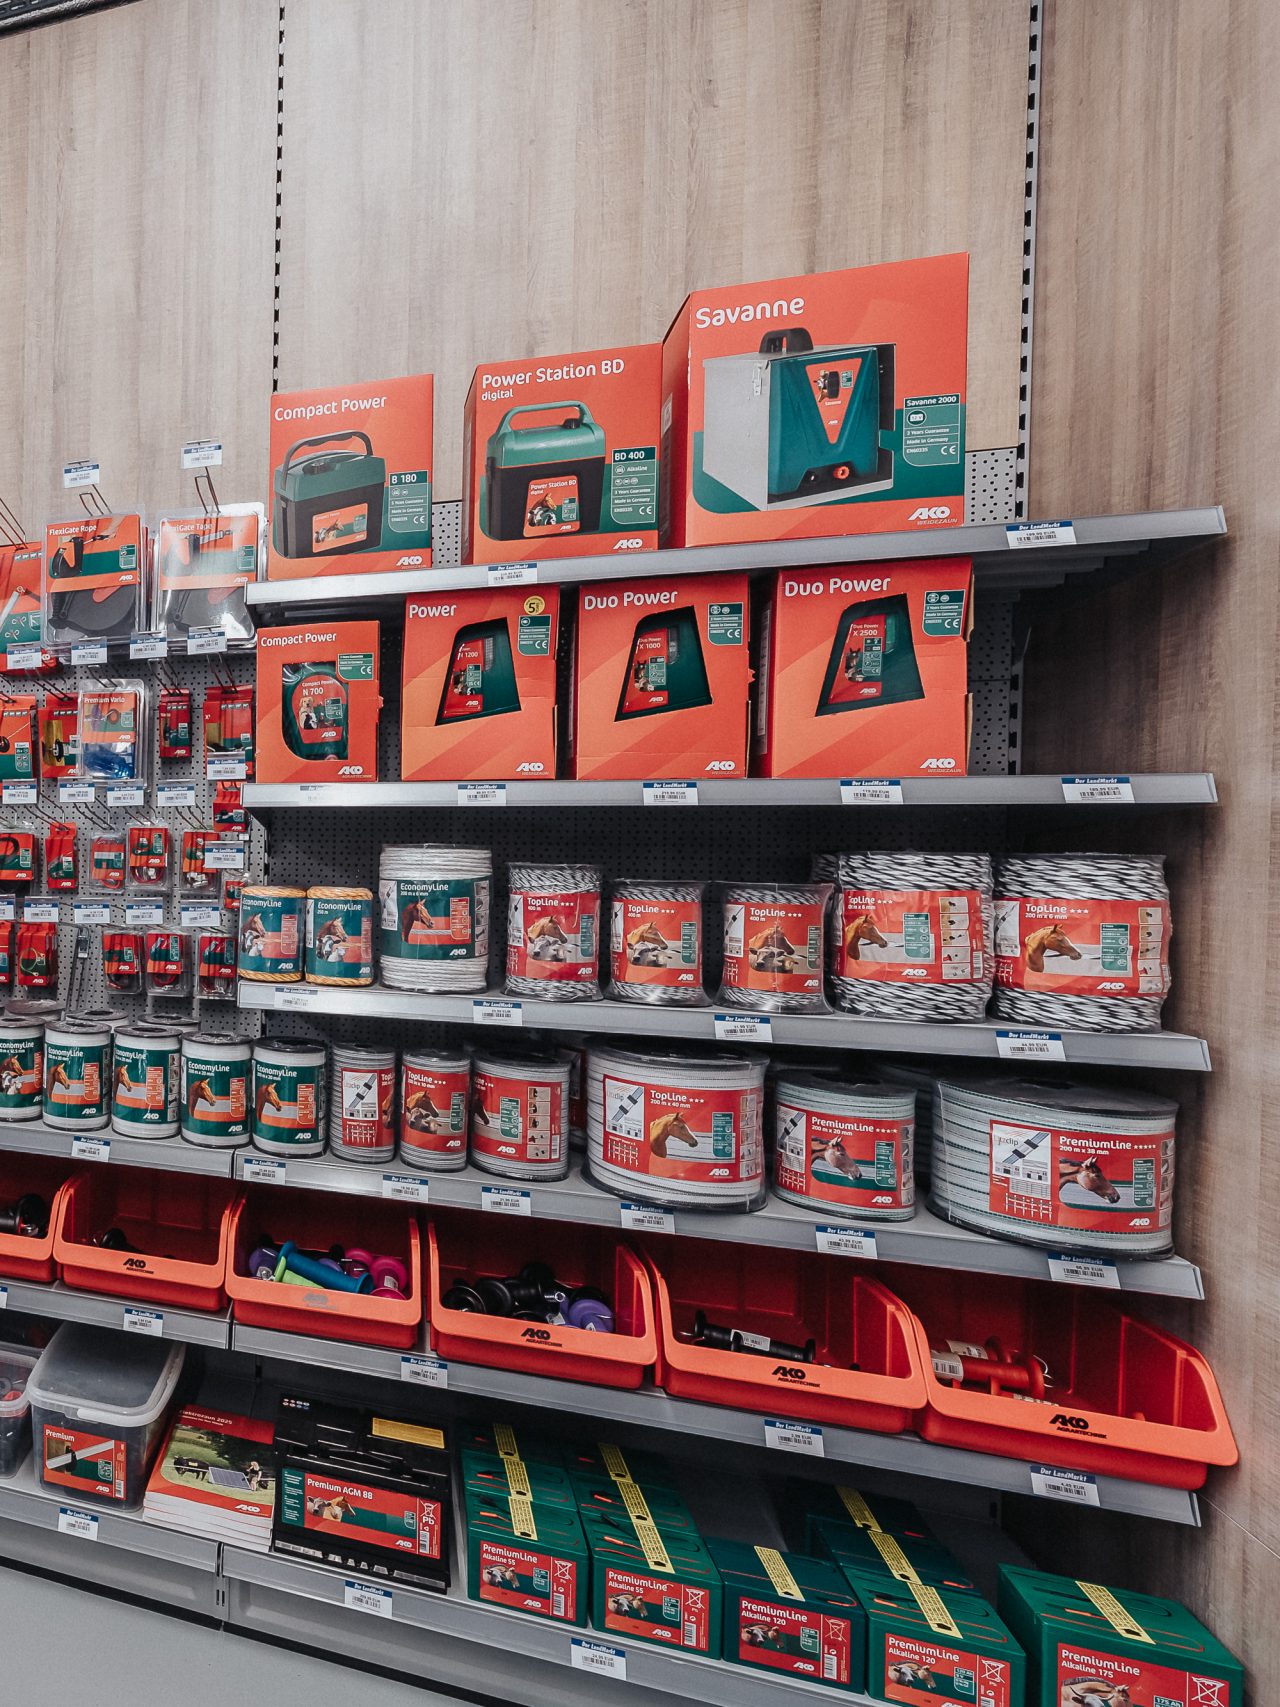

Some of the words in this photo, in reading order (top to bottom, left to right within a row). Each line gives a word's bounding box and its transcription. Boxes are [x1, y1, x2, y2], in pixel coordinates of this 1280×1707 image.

[695, 297, 805, 329] Savanne
[482, 371, 532, 389] Power
[536, 364, 596, 383] Station
[601, 359, 625, 374] BD
[481, 389, 514, 402] digital
[907, 398, 937, 407] Savanne
[938, 396, 957, 404] 2000
[274, 401, 338, 421] Compact
[341, 396, 387, 411] Power
[614, 452, 627, 461] BD
[628, 450, 645, 459] 400
[391, 475, 398, 484] B
[400, 473, 417, 483] 180
[908, 506, 951, 521] AKO
[49, 525, 79, 536] FlexiGate
[81, 523, 97, 533] Rope
[1030, 522, 1061, 530] LandMarkt
[785, 580, 825, 597] Duo
[829, 577, 891, 594] Power
[584, 594, 619, 611] Duo
[623, 589, 678, 607] Power
[409, 603, 457, 619] Power
[528, 602, 537, 614] 5
[260, 634, 303, 647] Compact
[305, 632, 337, 644] Power
[303, 688, 308, 696] N
[310, 687, 324, 695] 700
[515, 762, 544, 772] AKO
[704, 761, 736, 771] AKO
[919, 758, 956, 769] AKO
[337, 766, 363, 775] AKO
[400, 883, 449, 892] EconomyLine
[527, 897, 559, 907] TopLine
[1025, 903, 1067, 914] TopLine
[627, 904, 660, 914] TopLine
[750, 907, 785, 918] TopLine
[1019, 1032, 1050, 1040] LandMarkt
[188, 1061, 230, 1072] EconomyLine
[256, 1065, 297, 1078] EconomyLine
[407, 1070, 432, 1083] TopLine
[650, 1090, 687, 1103] TopLine
[812, 1116, 874, 1133] PremiumLine
[1059, 1136, 1132, 1150] PremiumLine
[836, 1228, 864, 1238] LandMarkt
[123, 1258, 146, 1268] AKO
[521, 1327, 551, 1340] AKO
[525, 1338, 563, 1348] AGRARTECHNIK
[771, 1366, 806, 1380] AKO
[777, 1377, 821, 1388] AGRARTECHNIK
[785, 1423, 812, 1434] LandMarkt
[1050, 1414, 1089, 1430] AKO
[45, 1429, 75, 1442] Premium
[1056, 1426, 1107, 1439] AGRARTECHNIK
[1040, 1467, 1052, 1475] Der
[1052, 1469, 1088, 1483] LandMarkt
[307, 1478, 342, 1495] Premium
[343, 1485, 361, 1498] AGM
[362, 1489, 374, 1500] 88
[422, 1516, 435, 1526] Pb
[482, 1543, 538, 1564] PremiumLine
[482, 1553, 507, 1566] Alkaline
[508, 1558, 516, 1566] 55
[608, 1571, 668, 1592] PremiumLine
[608, 1581, 635, 1593] Alkaline
[636, 1586, 644, 1594] 55
[741, 1600, 808, 1623] PremiumLine
[741, 1610, 770, 1623] Alkaline
[772, 1617, 786, 1626] 120
[581, 1640, 591, 1648] Der
[591, 1643, 616, 1655] LandMarkt
[888, 1637, 960, 1662] PremiumLine
[888, 1647, 919, 1662] Alkaline
[921, 1655, 936, 1665] 120
[793, 1661, 815, 1673] AKO
[1061, 1649, 1140, 1677] PremiumLine
[1061, 1660, 1096, 1676] Alkaline
[1098, 1668, 1114, 1679] 175
[1155, 1696, 1169, 1705] 175
